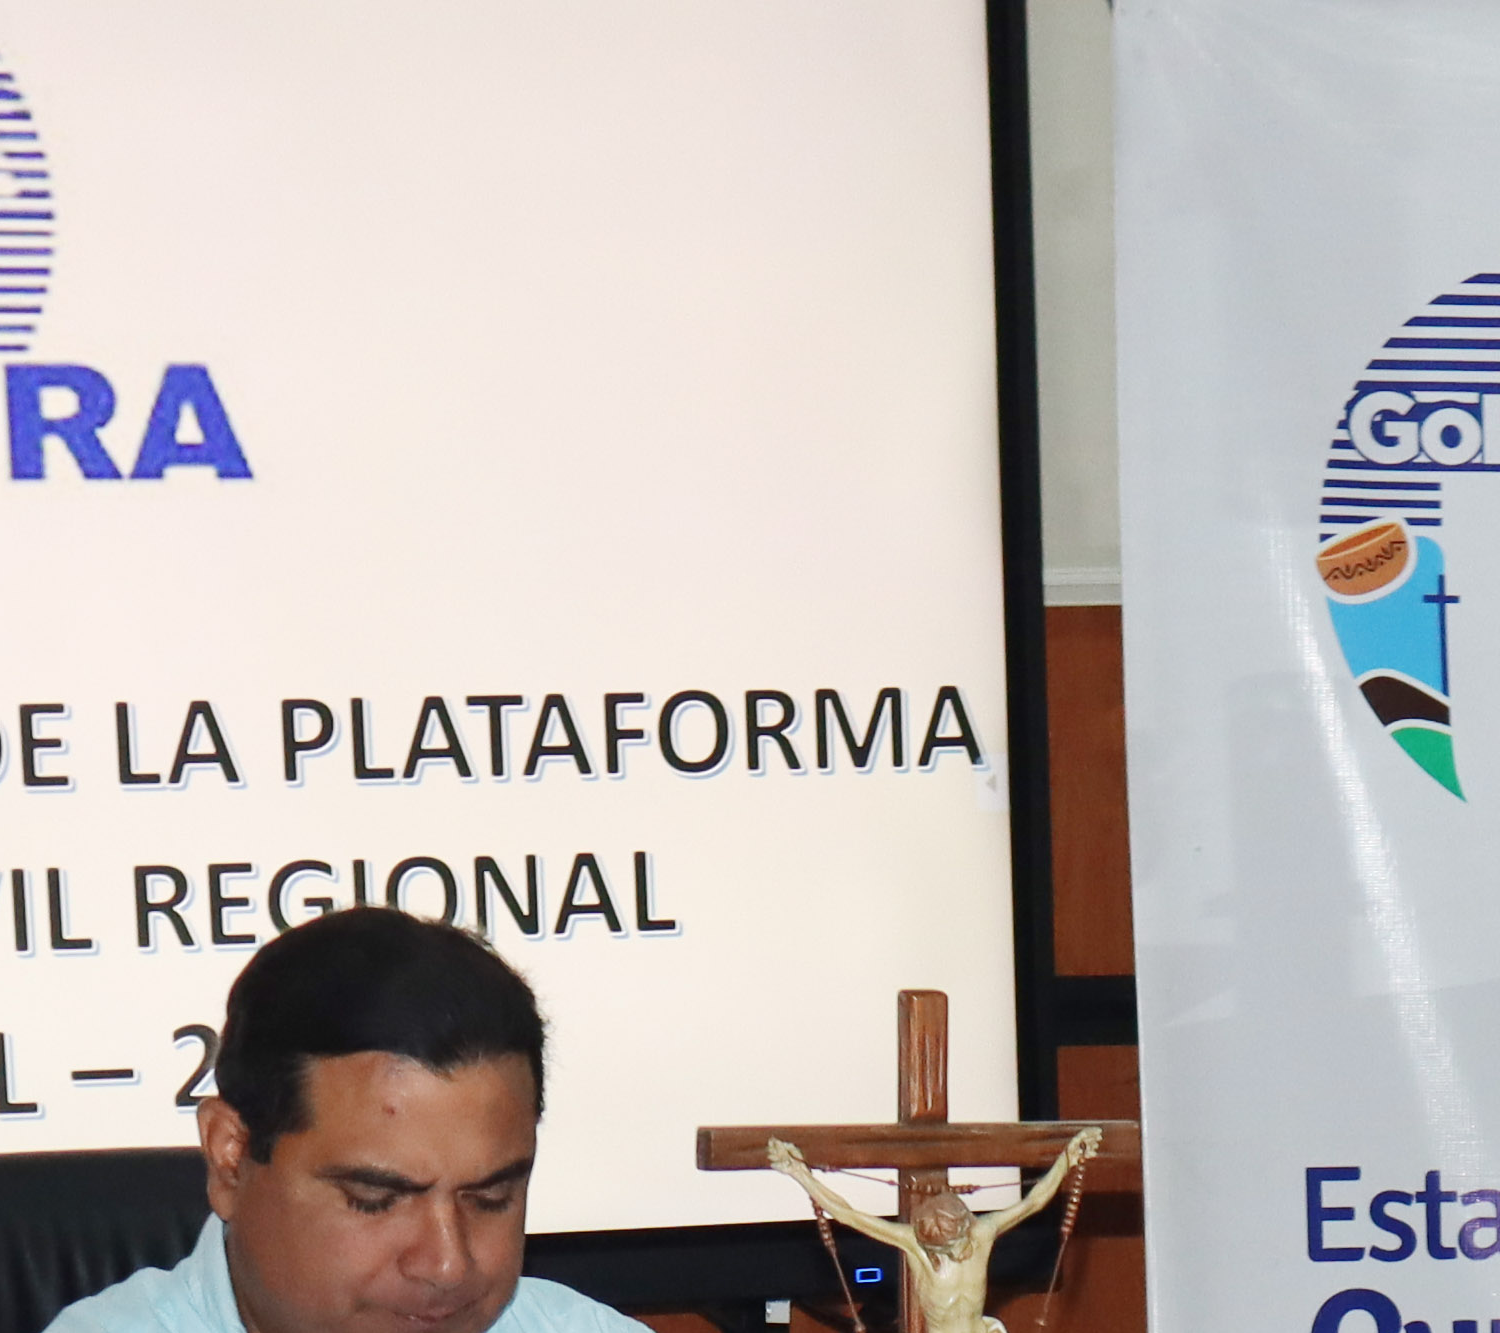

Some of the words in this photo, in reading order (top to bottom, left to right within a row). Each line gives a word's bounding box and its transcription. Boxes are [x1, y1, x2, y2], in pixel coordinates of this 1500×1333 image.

[114, 699, 241, 787] LA
[280, 684, 984, 784] PLATAFORMA
[134, 852, 676, 947] REGIONAL
